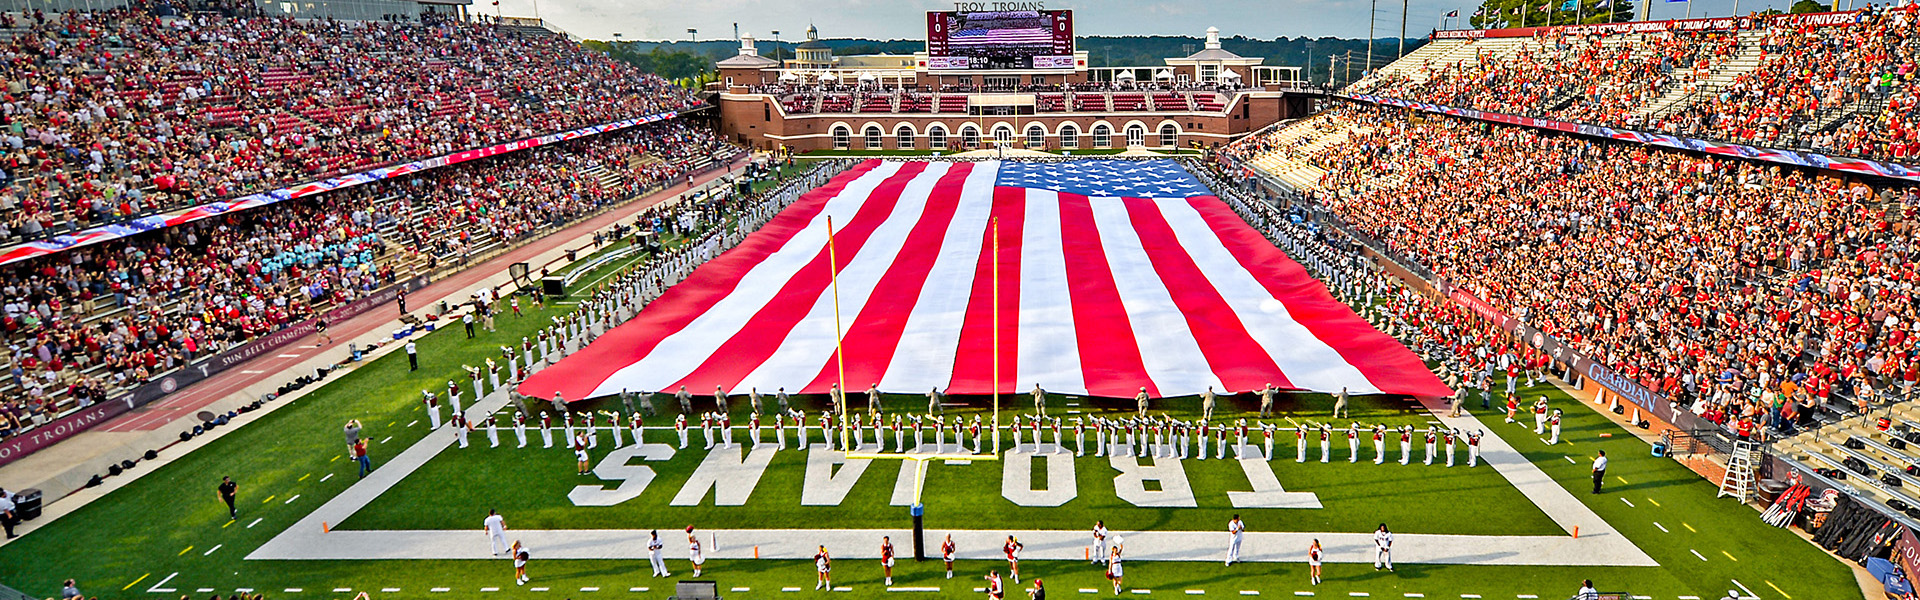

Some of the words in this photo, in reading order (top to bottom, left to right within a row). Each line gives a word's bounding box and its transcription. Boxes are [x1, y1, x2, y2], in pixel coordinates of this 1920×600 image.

[954, 2, 985, 12] TROY
[992, 1, 1045, 11] TROJANS
[935, 23, 941, 32] 0
[1060, 22, 1066, 31] 0
[1457, 293, 1471, 306] TROY
[1471, 299, 1497, 320] TROJANS
[222, 352, 242, 366] SUN
[245, 342, 265, 357] BELT
[1588, 363, 1658, 413] GUARDIAN
[1598, 380, 1619, 392] CREDIT
[1619, 391, 1639, 404] UNION
[31, 408, 105, 445] TROJANS
[566, 443, 1324, 509] TROJANS
